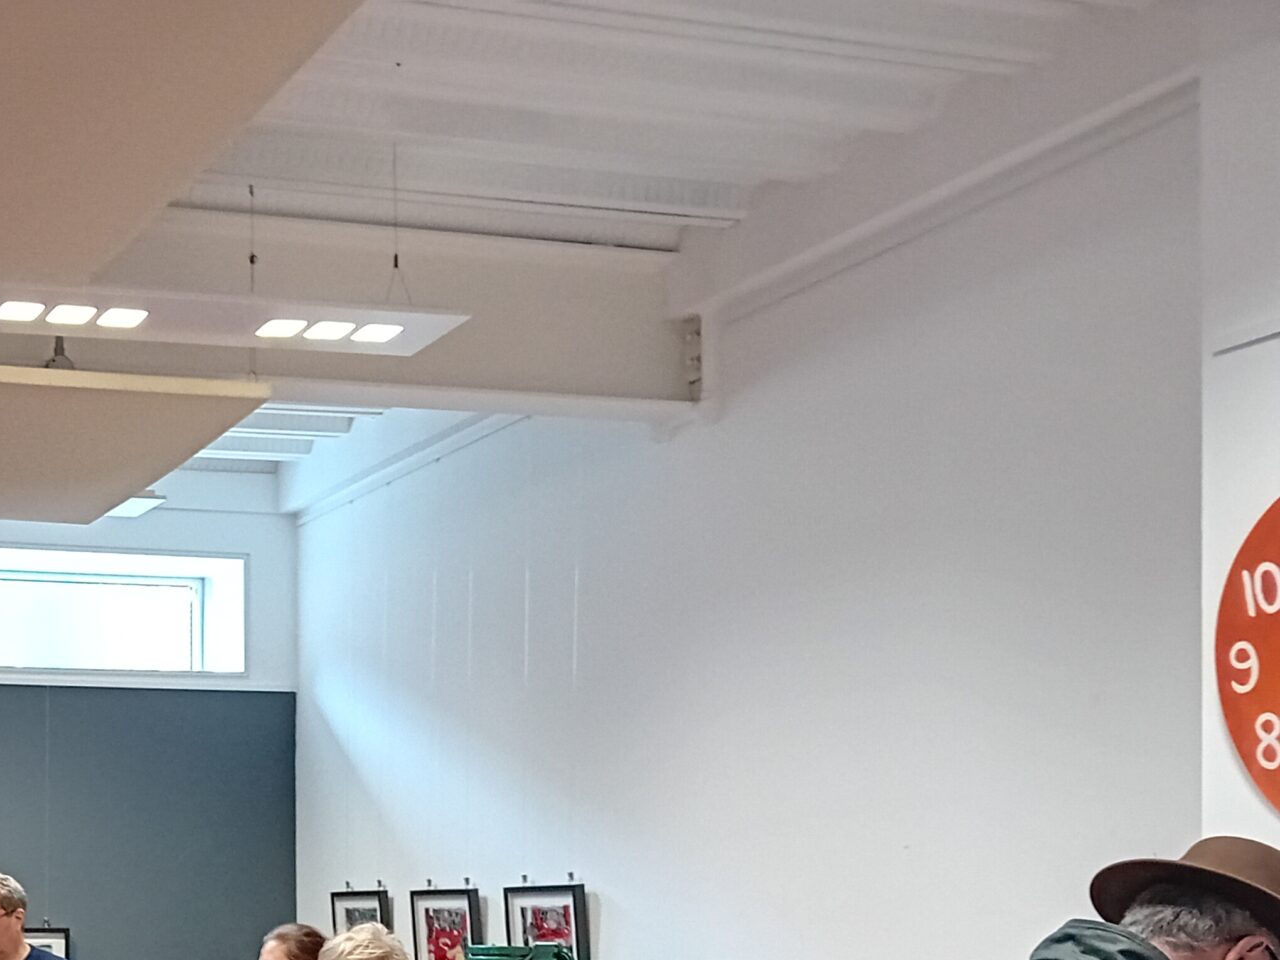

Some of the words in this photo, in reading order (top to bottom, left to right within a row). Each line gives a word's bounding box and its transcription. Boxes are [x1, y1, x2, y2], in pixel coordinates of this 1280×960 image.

[1241, 561, 1280, 617] 10
[1229, 640, 1259, 694] 9
[1254, 712, 1280, 770] 8
